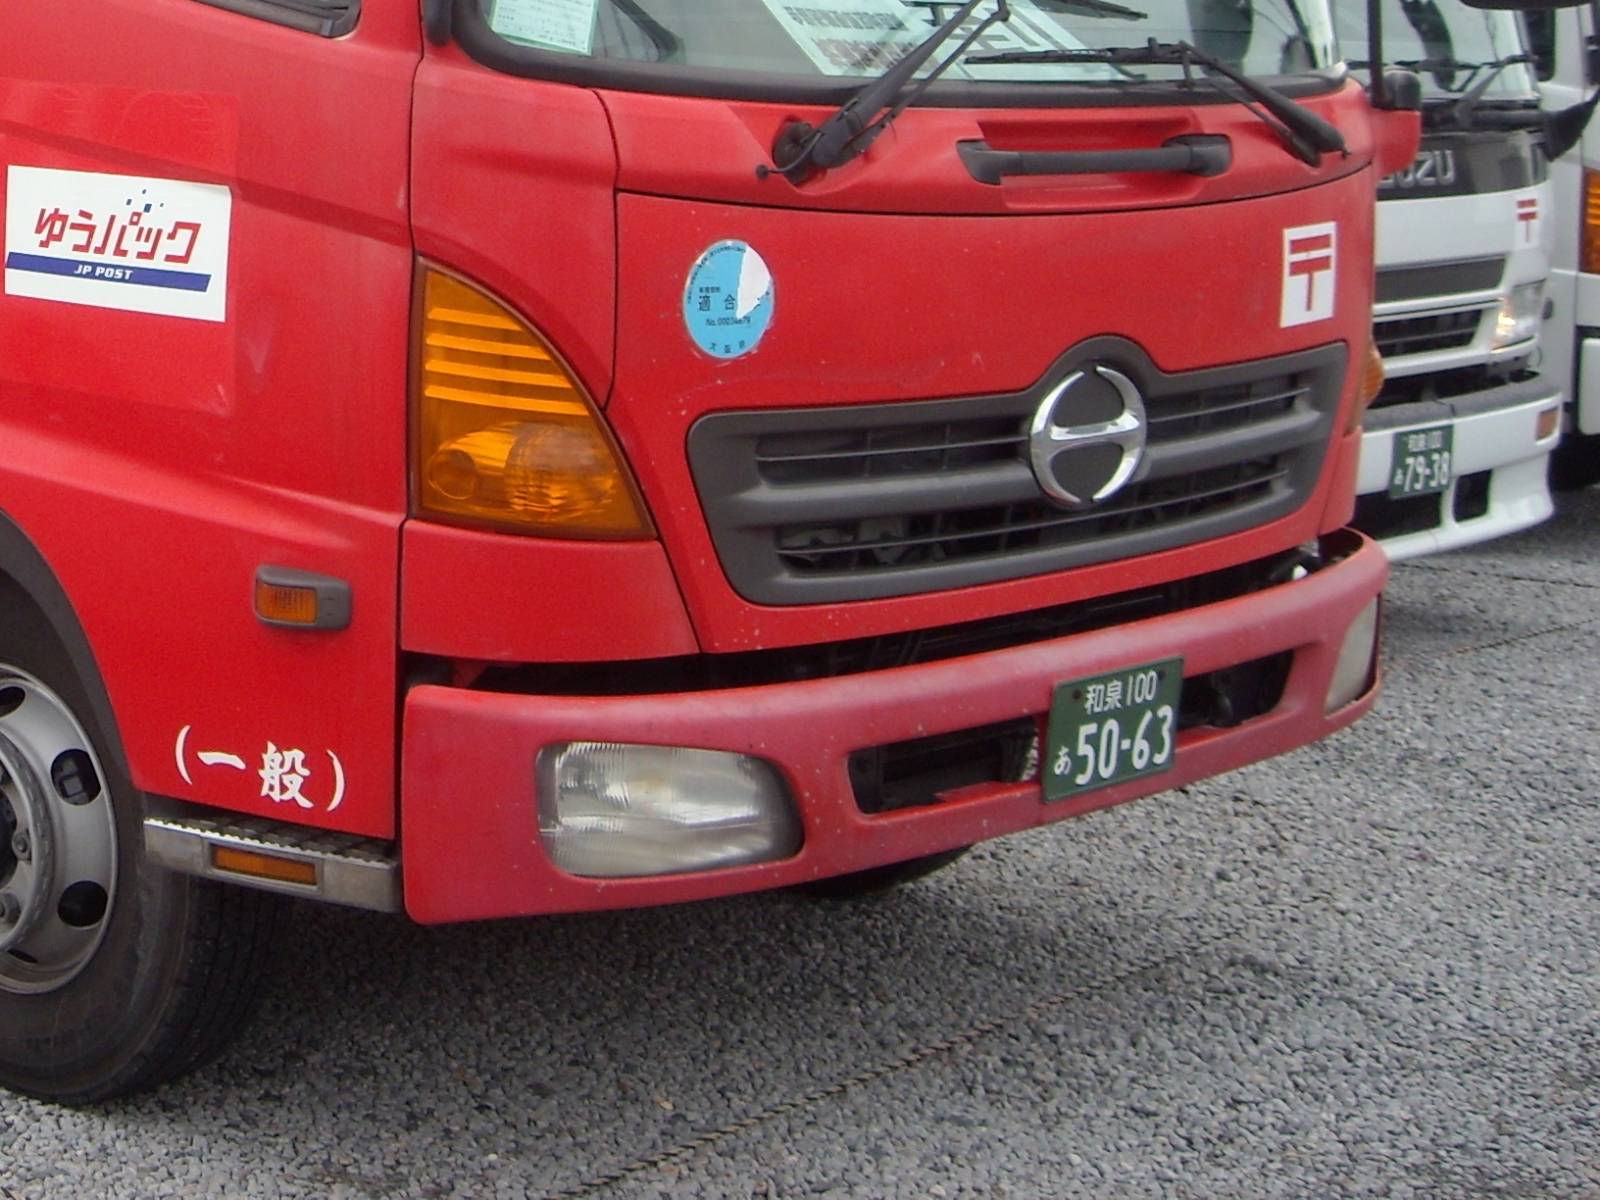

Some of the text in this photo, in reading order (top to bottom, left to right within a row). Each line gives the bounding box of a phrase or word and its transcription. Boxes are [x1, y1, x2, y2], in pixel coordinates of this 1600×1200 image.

[34, 208, 202, 265] ゆうパック
[73, 264, 134, 281] JP POST
[1404, 451, 1451, 492] 79-38
[1084, 670, 1158, 715] 和泉 100
[1054, 704, 1173, 785] あ 50-63
